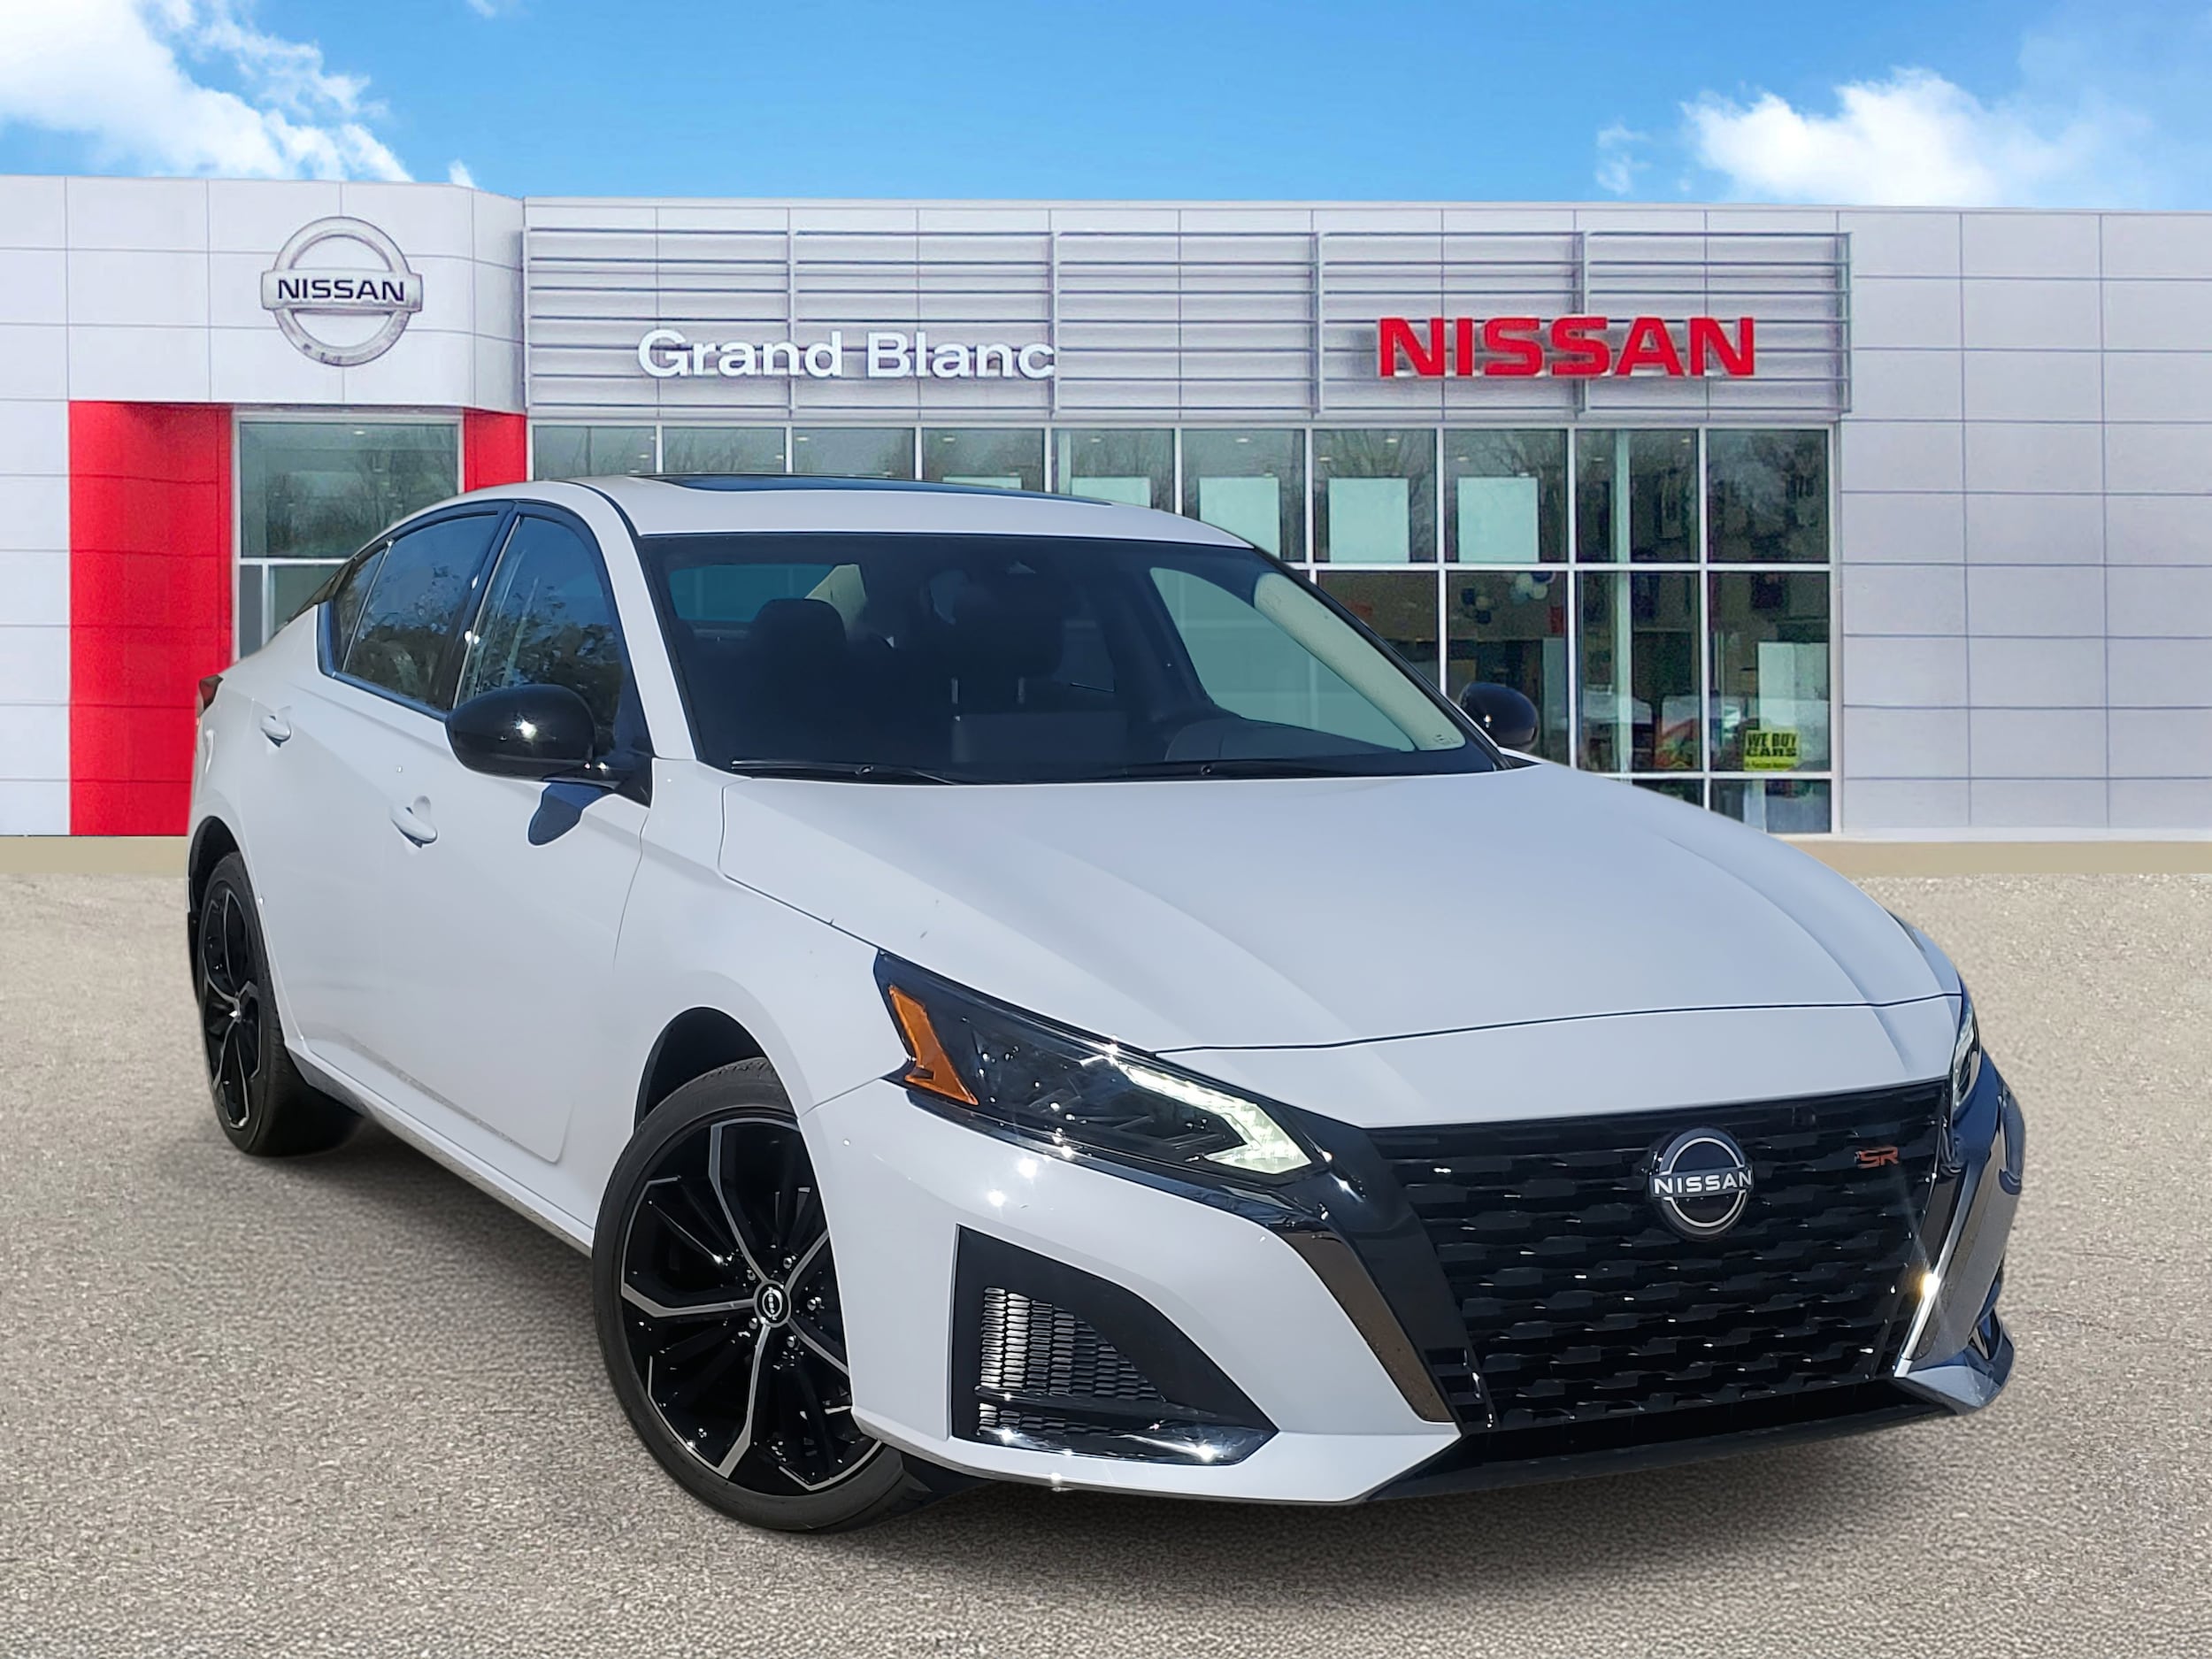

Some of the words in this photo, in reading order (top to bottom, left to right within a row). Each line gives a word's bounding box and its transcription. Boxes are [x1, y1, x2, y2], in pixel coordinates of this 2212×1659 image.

[278, 278, 405, 302] NISSAN
[637, 328, 842, 379] Grand
[866, 330, 1056, 380] Blanc
[1378, 316, 1755, 379] NISSAN
[1746, 747, 1797, 757] CARS
[1747, 733, 1768, 748] WE
[1771, 733, 1797, 748] BUY
[1855, 1146, 1900, 1169] SR
[1653, 1170, 1754, 1195] NISSAN
